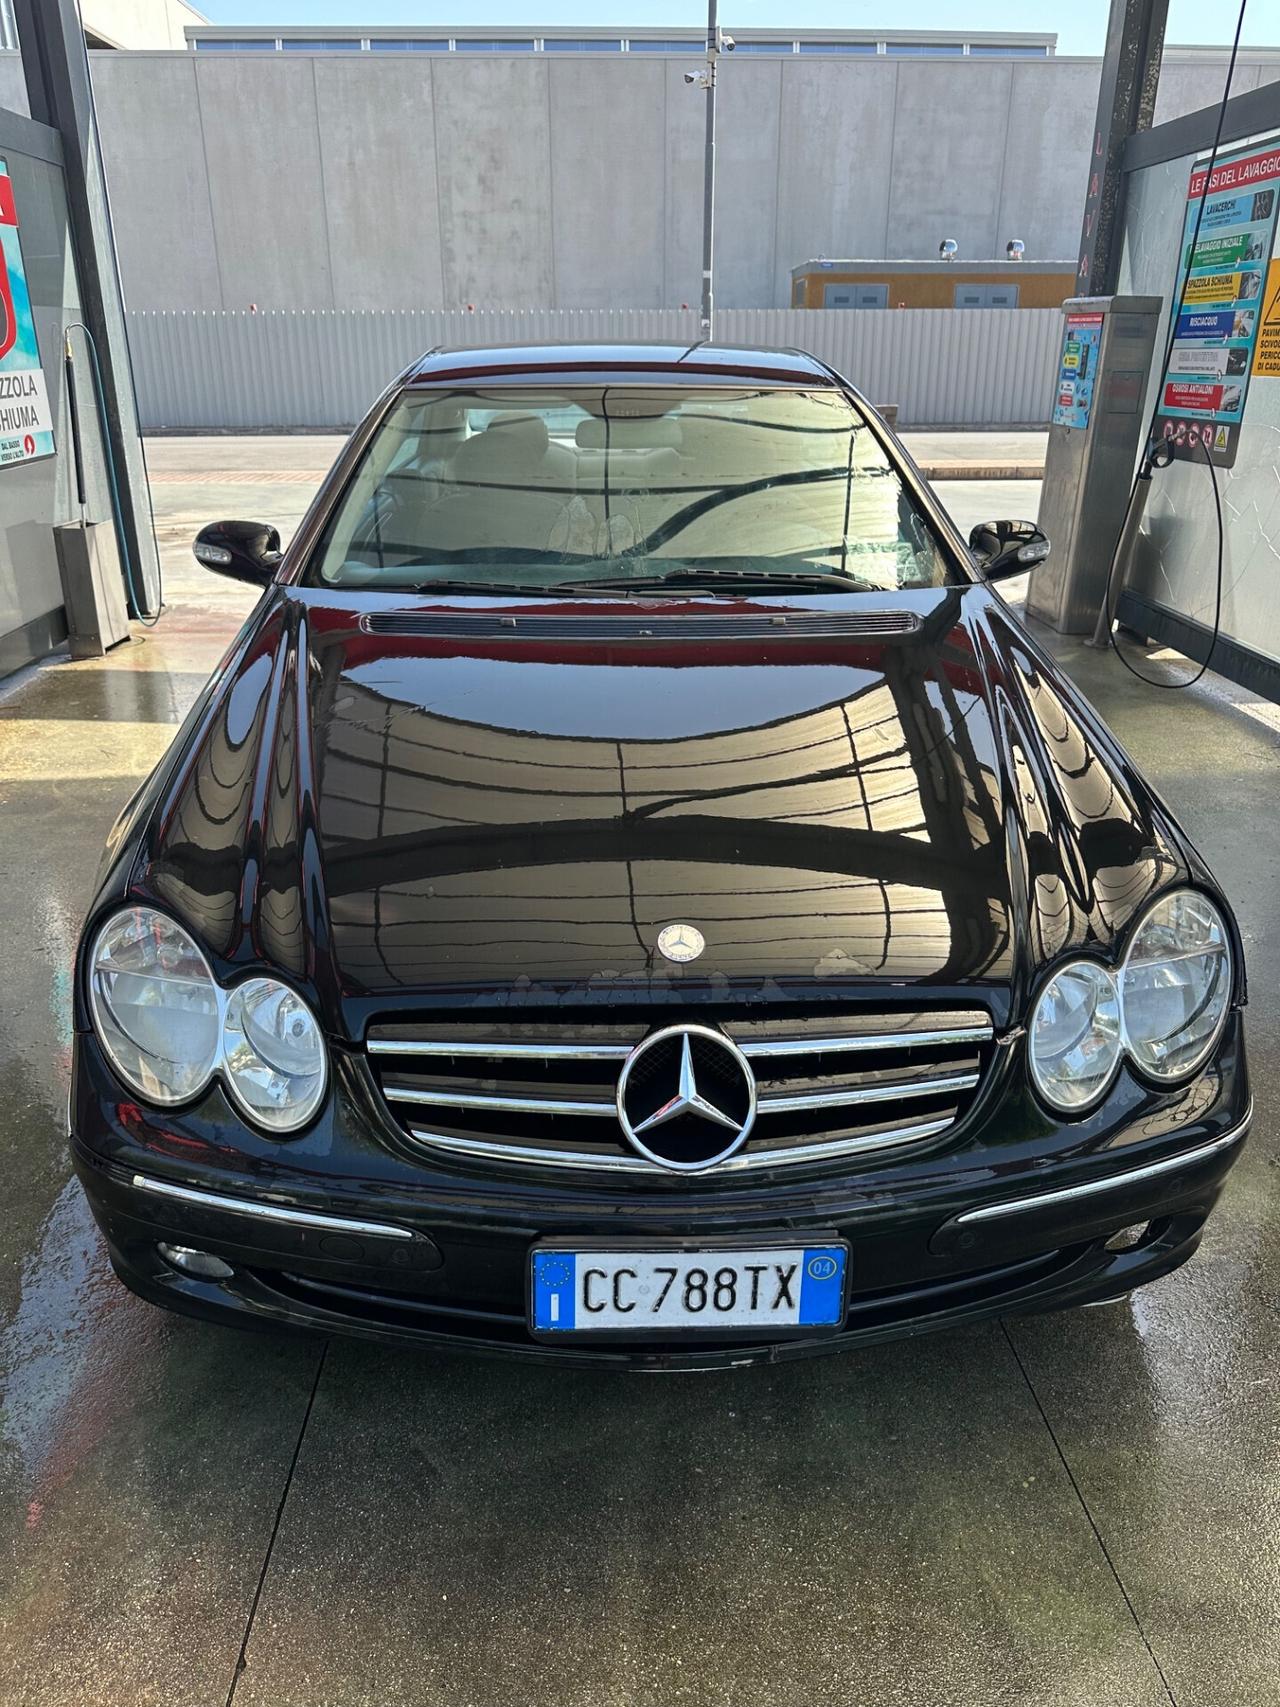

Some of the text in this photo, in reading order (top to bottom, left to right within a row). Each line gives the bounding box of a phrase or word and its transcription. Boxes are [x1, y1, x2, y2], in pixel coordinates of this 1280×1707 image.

[1191, 178, 1202, 193] LE
[1220, 168, 1236, 186] DEL
[1189, 239, 1221, 254] ELAVAGGIO
[1187, 277, 1210, 289] SPAZZOLA
[1257, 362, 1264, 370] DI
[813, 1262, 831, 1274] 04
[583, 1263, 798, 1313] CC 788TX
[550, 1293, 559, 1321] I
